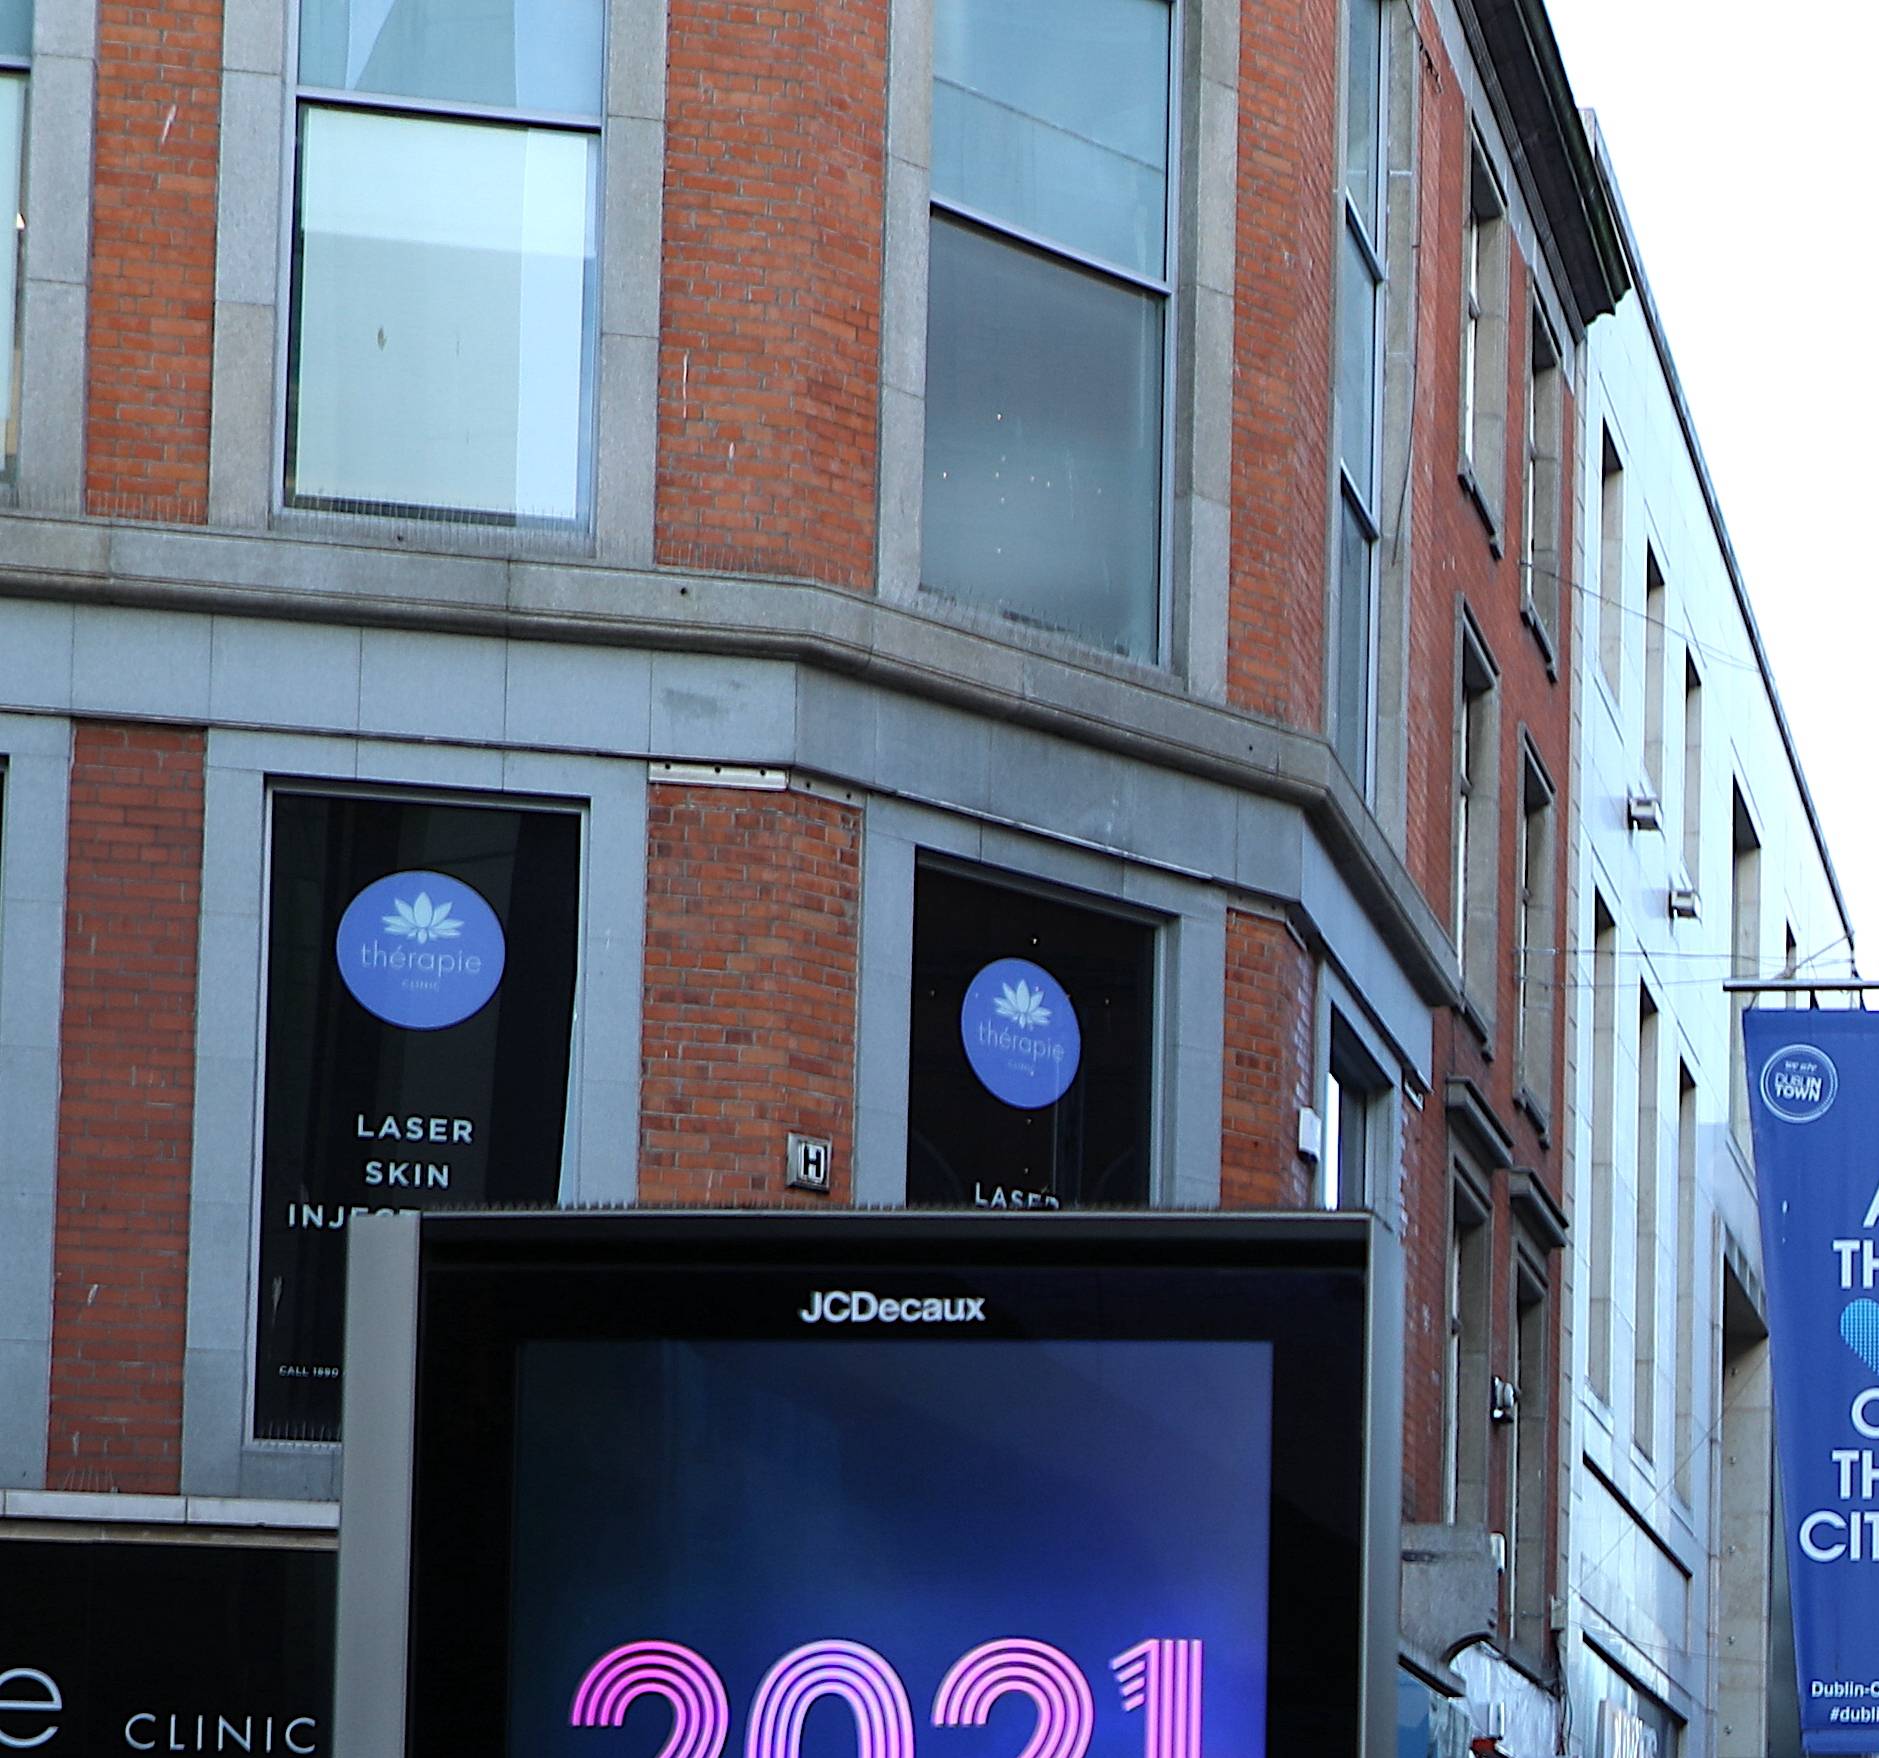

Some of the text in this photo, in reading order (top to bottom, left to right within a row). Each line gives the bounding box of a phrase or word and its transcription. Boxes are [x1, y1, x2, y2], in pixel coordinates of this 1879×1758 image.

[361, 940, 482, 977] thérapie
[979, 1020, 1065, 1062] thérapie
[1775, 1085, 1822, 1102] TOWN
[357, 1114, 474, 1144] LASER
[364, 1160, 450, 1190] SKIN
[802, 1146, 824, 1182] H
[801, 1291, 986, 1323] JCDecaux
[279, 1364, 309, 1377] CALL
[124, 1713, 318, 1755] CLINIC
